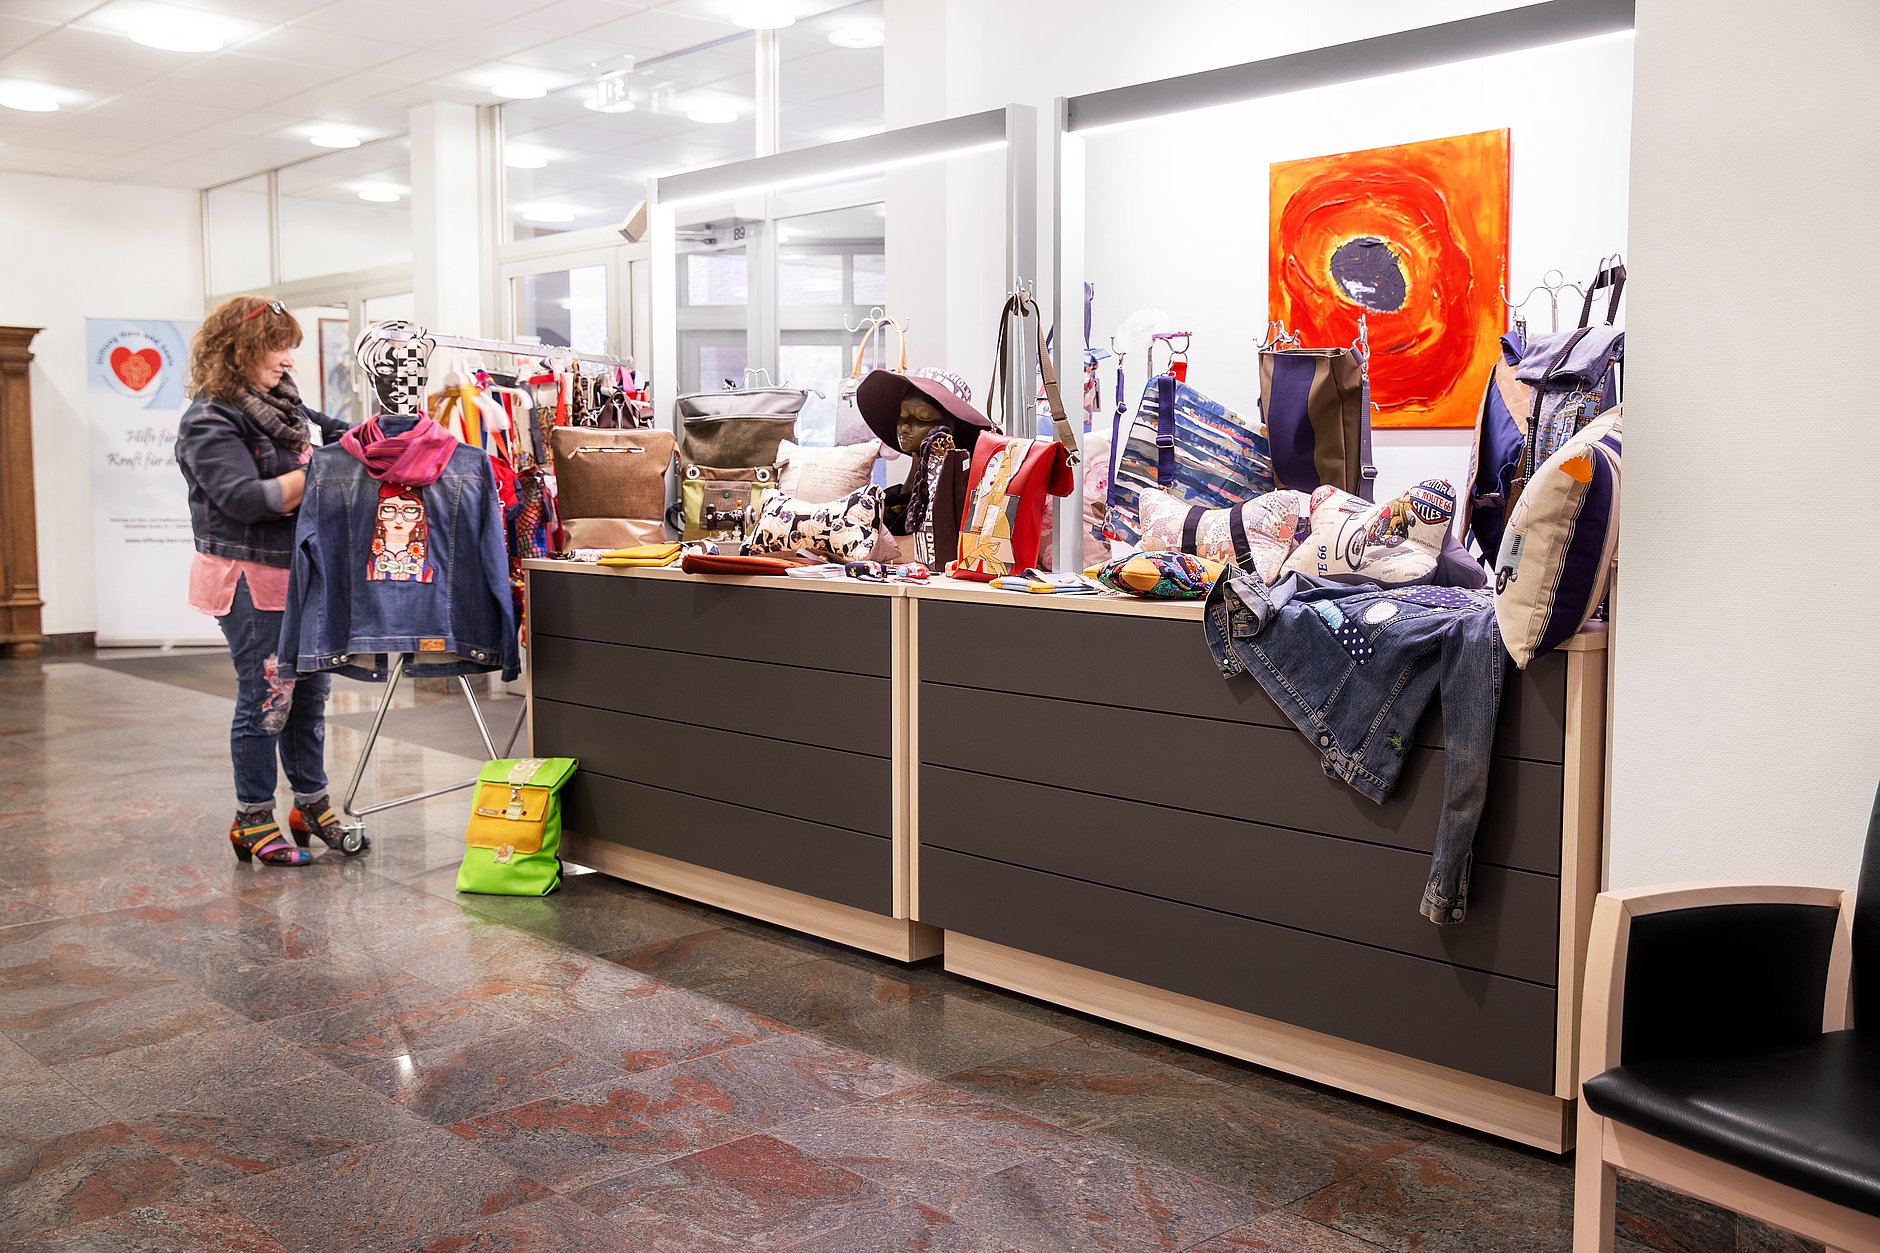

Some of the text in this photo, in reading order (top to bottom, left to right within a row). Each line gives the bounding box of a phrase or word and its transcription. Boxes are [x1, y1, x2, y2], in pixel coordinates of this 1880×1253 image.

[1421, 491, 1443, 509] ROUTE
[1443, 500, 1452, 513] 66
[1316, 545, 1328, 560] 66
